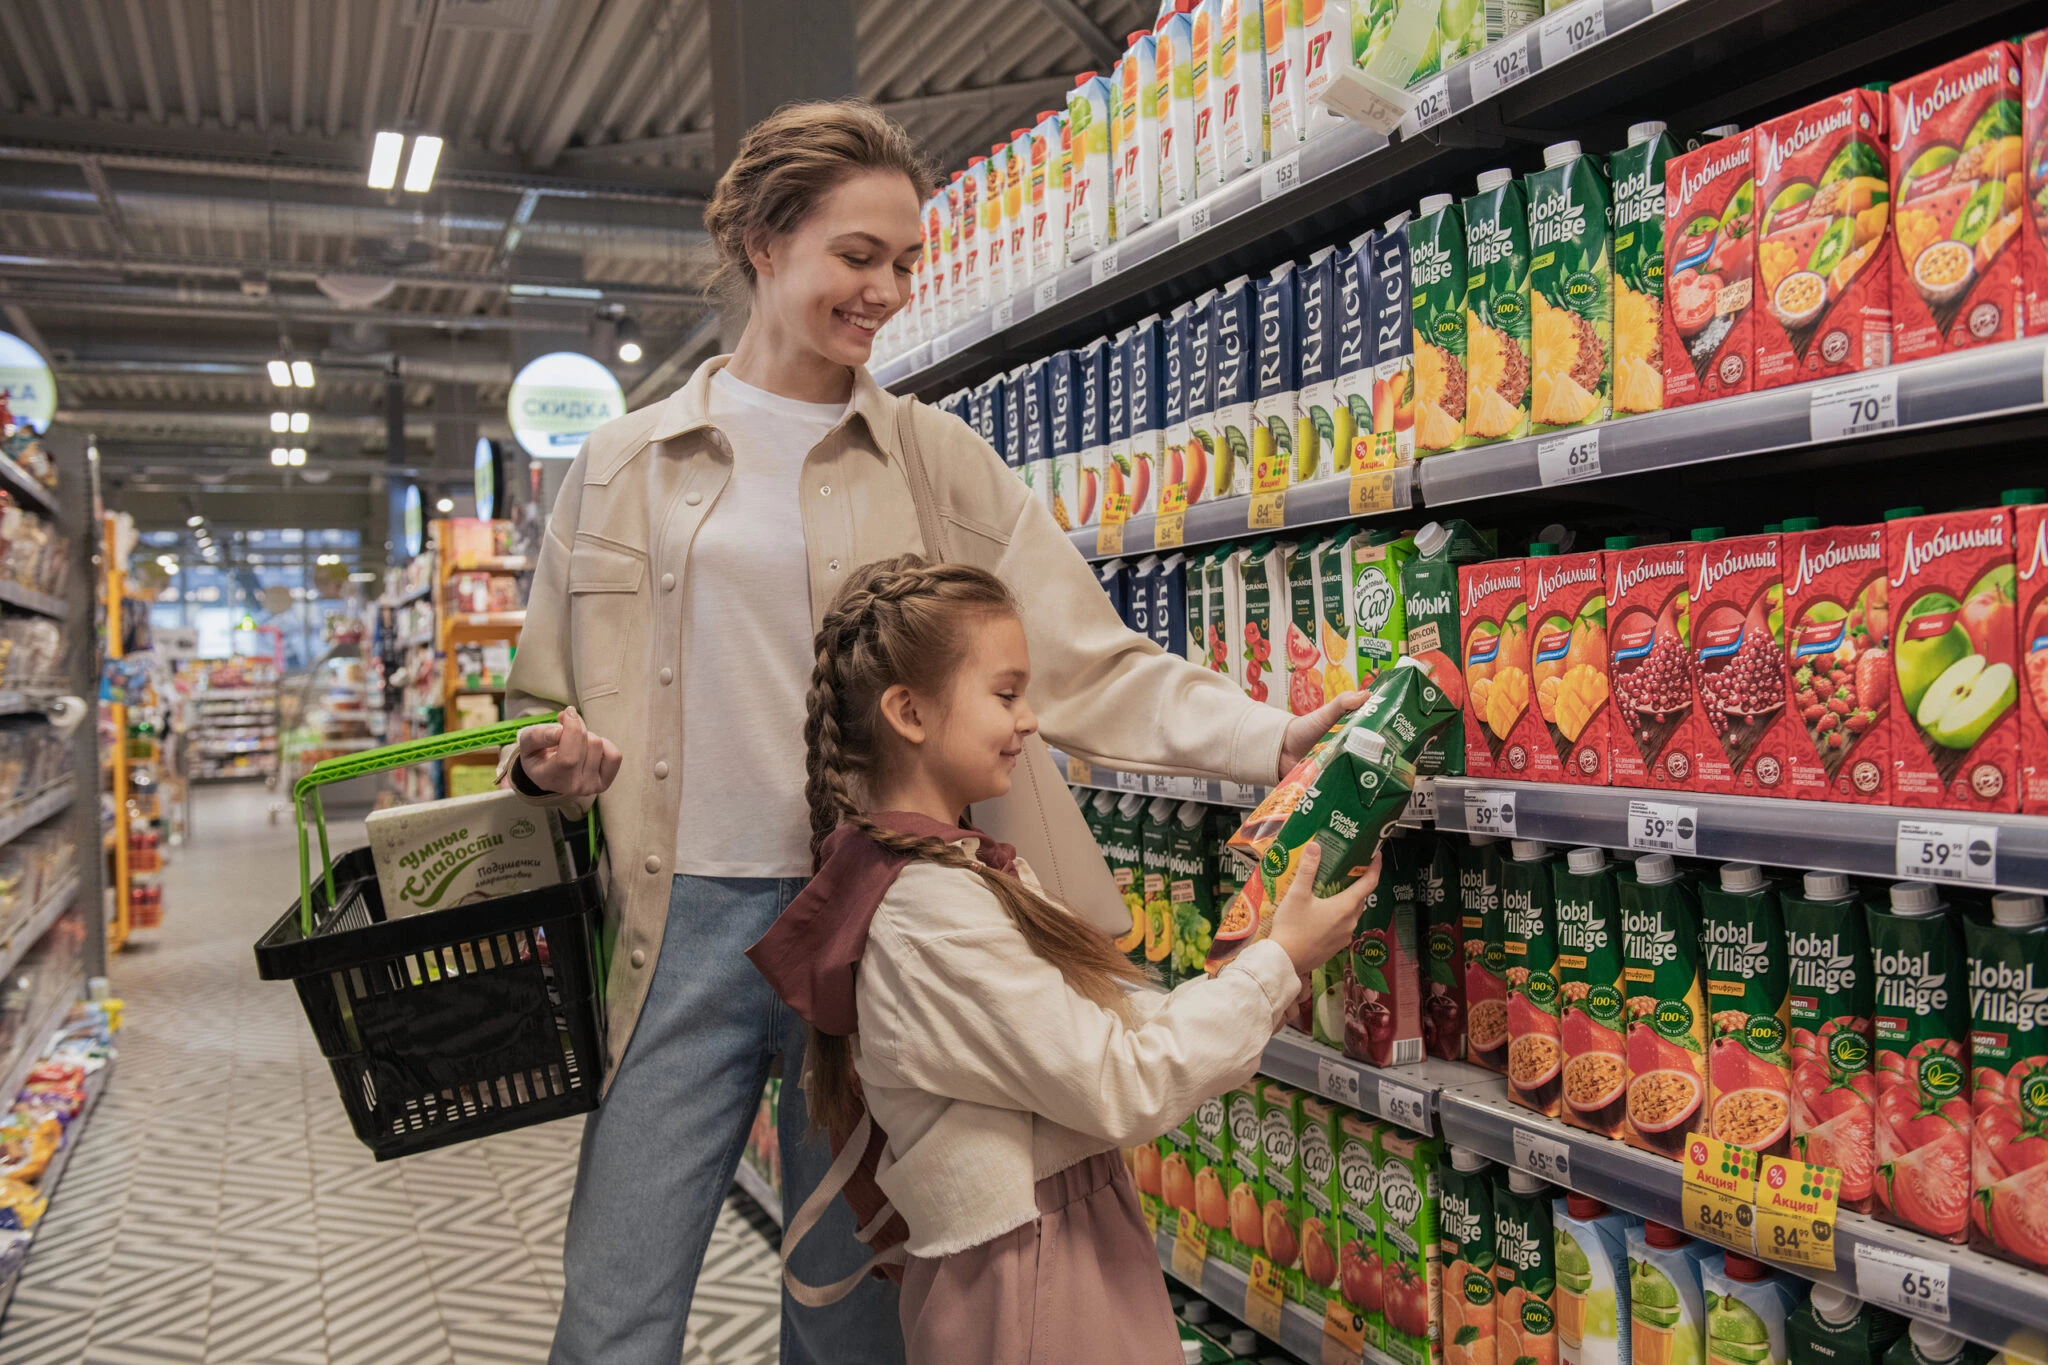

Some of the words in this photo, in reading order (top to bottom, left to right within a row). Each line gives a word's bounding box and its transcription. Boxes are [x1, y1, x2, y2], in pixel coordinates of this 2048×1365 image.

[1567, 17, 1595, 45] 102
[1305, 30, 1332, 77] J7
[1493, 52, 1519, 79] 102
[1269, 59, 1292, 102] J7
[1223, 84, 1240, 124] J7
[1414, 95, 1439, 121] 102
[1891, 50, 2000, 152] Любимый
[1196, 107, 1212, 146] J7
[1160, 128, 1173, 163] J7
[1756, 96, 1853, 187] Любимый
[1125, 146, 1139, 178] J7
[1276, 166, 1293, 183] 153
[1612, 167, 1665, 200] lobal
[1668, 137, 1750, 218] Любимый
[1073, 178, 1090, 212] J7
[1033, 212, 1047, 241] J7
[1191, 212, 1205, 227] 153
[1467, 212, 1512, 244] lobal
[989, 239, 1004, 266] J7
[1011, 227, 1024, 255] J7
[1410, 234, 1451, 266] lobal
[1379, 244, 1403, 356] Rich
[1569, 284, 1594, 295] 100%
[1340, 260, 1362, 368] Rich
[1497, 304, 1520, 314] 100%
[1259, 292, 1281, 390] Rich
[1302, 278, 1322, 379] Rich
[1438, 323, 1461, 332] 100%
[1189, 320, 1209, 410] Rich
[1218, 307, 1240, 400] Rich
[1132, 344, 1148, 426] Rich
[1166, 332, 1181, 420] Rich
[1082, 365, 1096, 443] Rich
[1109, 354, 1123, 435] Rich
[523, 400, 612, 419] СКИДКА
[1028, 382, 1041, 456] Rich
[1054, 374, 1068, 449] Rich
[1850, 398, 1879, 425] 70
[1007, 391, 1019, 462] Rich
[1569, 444, 1588, 466] 65
[1360, 486, 1375, 502] 84
[1256, 503, 1269, 517] 84
[1161, 526, 1172, 540] 84
[1786, 531, 1880, 596] Любимый
[1891, 514, 2003, 587] Любимый
[1290, 579, 1313, 588] GRANDE
[1528, 558, 1597, 611] Любимый
[1607, 550, 1684, 607] Любимый
[1690, 540, 1777, 602] Любимый
[1359, 589, 1386, 621] Сад
[1461, 566, 1521, 617] Любимый
[1407, 591, 1451, 621] обрый
[1422, 625, 1437, 638] СОК
[1409, 645, 1420, 655] БЕЗ
[1392, 719, 1413, 742] Village
[1395, 713, 1418, 733] Global
[1329, 818, 1358, 840] Village
[1331, 809, 1359, 832] Global
[1476, 808, 1492, 824] 59
[1645, 819, 1665, 838] 59
[1170, 853, 1204, 877] обрый
[1921, 842, 1949, 864] 59
[1953, 843, 1963, 851] 99
[400, 833, 504, 901] Сладости
[478, 858, 541, 878] Подушечки
[1460, 869, 1496, 895] lobal
[1502, 889, 1542, 918] lobal
[1556, 899, 1606, 931] lobal
[1364, 948, 1384, 957] 100%
[1785, 931, 1854, 968] lobal
[1871, 947, 1946, 988] lobal
[1531, 982, 1552, 991] 100%
[1593, 996, 1616, 1006] 100%
[1660, 1013, 1687, 1022] 100%
[1751, 1027, 1779, 1038] 100%
[1328, 1074, 1341, 1090] 65
[1197, 1102, 1220, 1126] Сад
[1390, 1098, 1404, 1115] 65
[1233, 1117, 1258, 1141] Сад
[1266, 1131, 1294, 1157] Сад
[1304, 1146, 1331, 1173] Сад
[1529, 1150, 1546, 1170] 65
[1343, 1165, 1376, 1192] Сад
[1696, 1169, 1738, 1192] Акция!
[1385, 1184, 1417, 1213] Сад
[1439, 1189, 1480, 1225] lobal
[1772, 1193, 1819, 1214] Акция!
[1701, 1204, 1724, 1228] 84
[1724, 1211, 1733, 1221] 99
[1737, 1209, 1751, 1220] 1+1
[1494, 1212, 1540, 1250] lobal
[1774, 1226, 1799, 1249] 84
[1799, 1229, 1809, 1238] 99
[1814, 1225, 1829, 1235] 1+1
[1467, 1283, 1489, 1294] 100%
[1902, 1272, 1931, 1299] 65
[1933, 1278, 1946, 1289] 99
[1526, 1311, 1549, 1323] 100%
